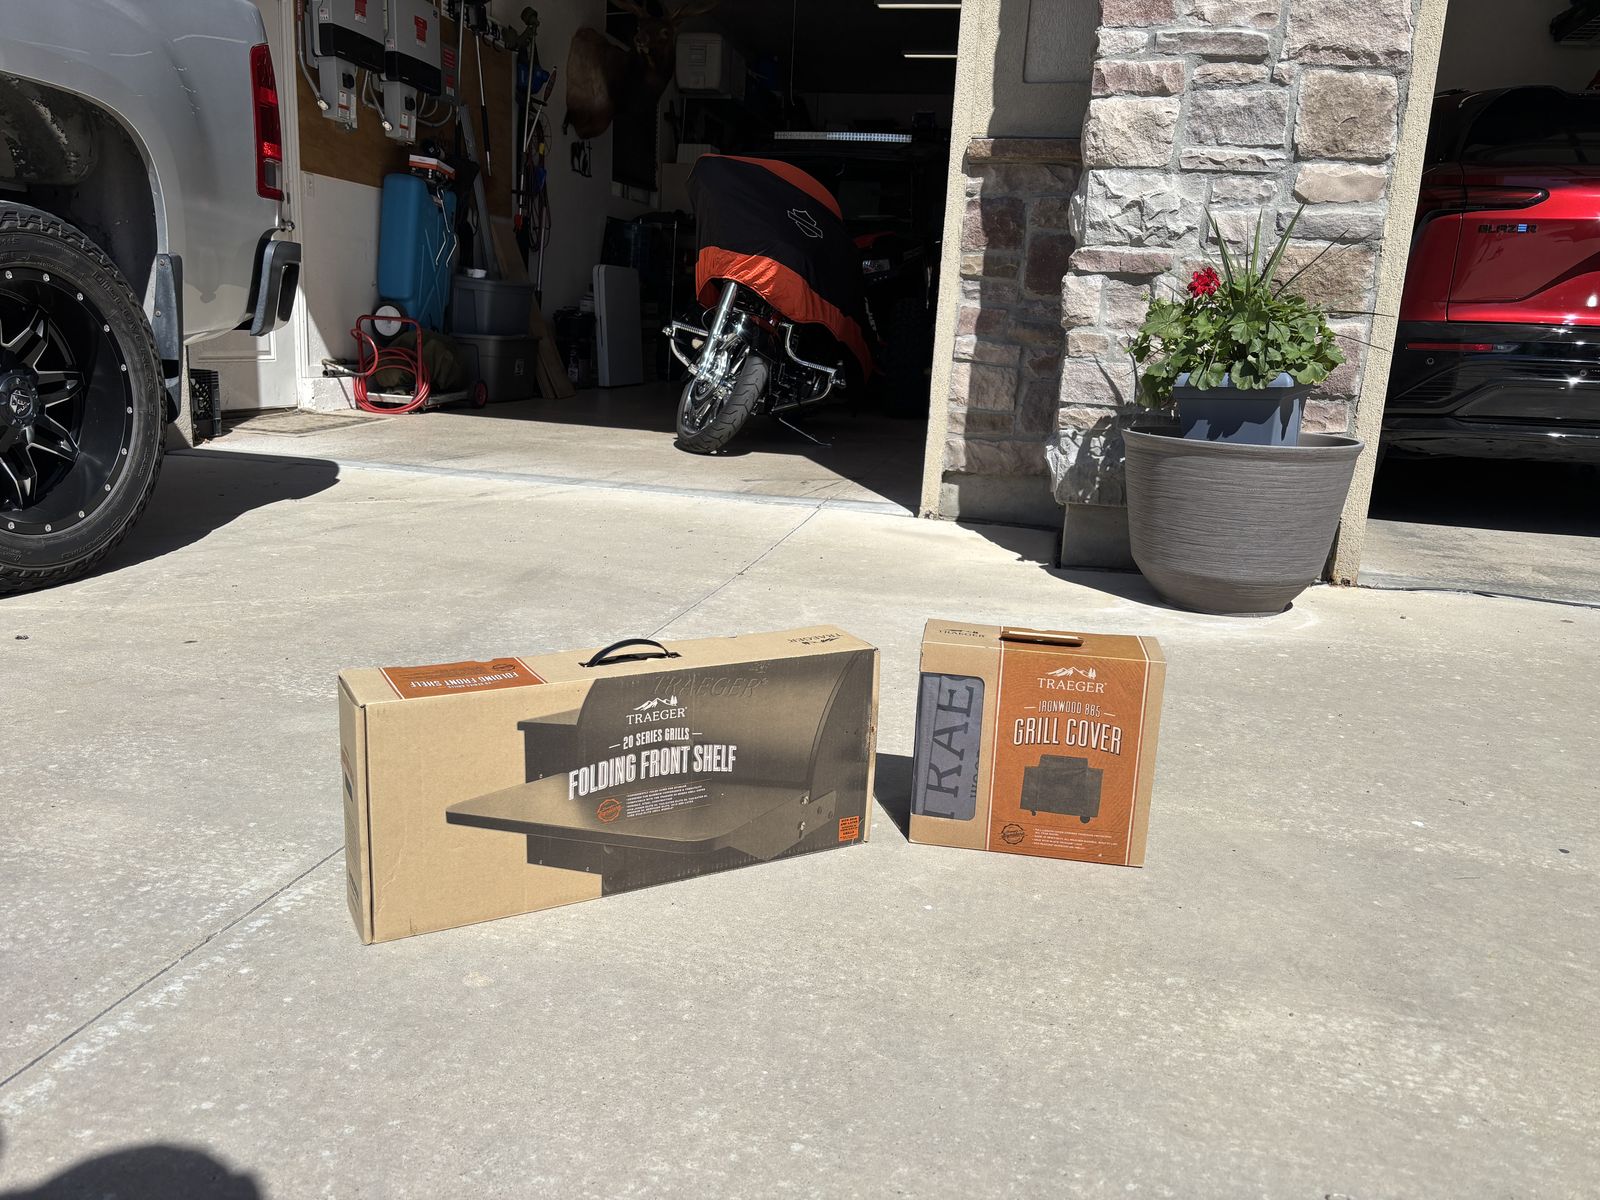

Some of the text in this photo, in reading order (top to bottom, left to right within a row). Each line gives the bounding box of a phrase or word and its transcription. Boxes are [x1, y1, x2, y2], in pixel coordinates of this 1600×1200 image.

[1478, 223, 1537, 233] BLAZER
[409, 680, 442, 688] SHELF
[444, 677, 477, 685] FRONT
[479, 671, 519, 683] FOLDING
[1038, 700, 1101, 717] IRONWOOD 885
[622, 727, 690, 750] 20 SERIES GRILLS
[1012, 717, 1123, 755] GRILL COVER
[568, 744, 737, 800] FOLDING FRONT SHELF
